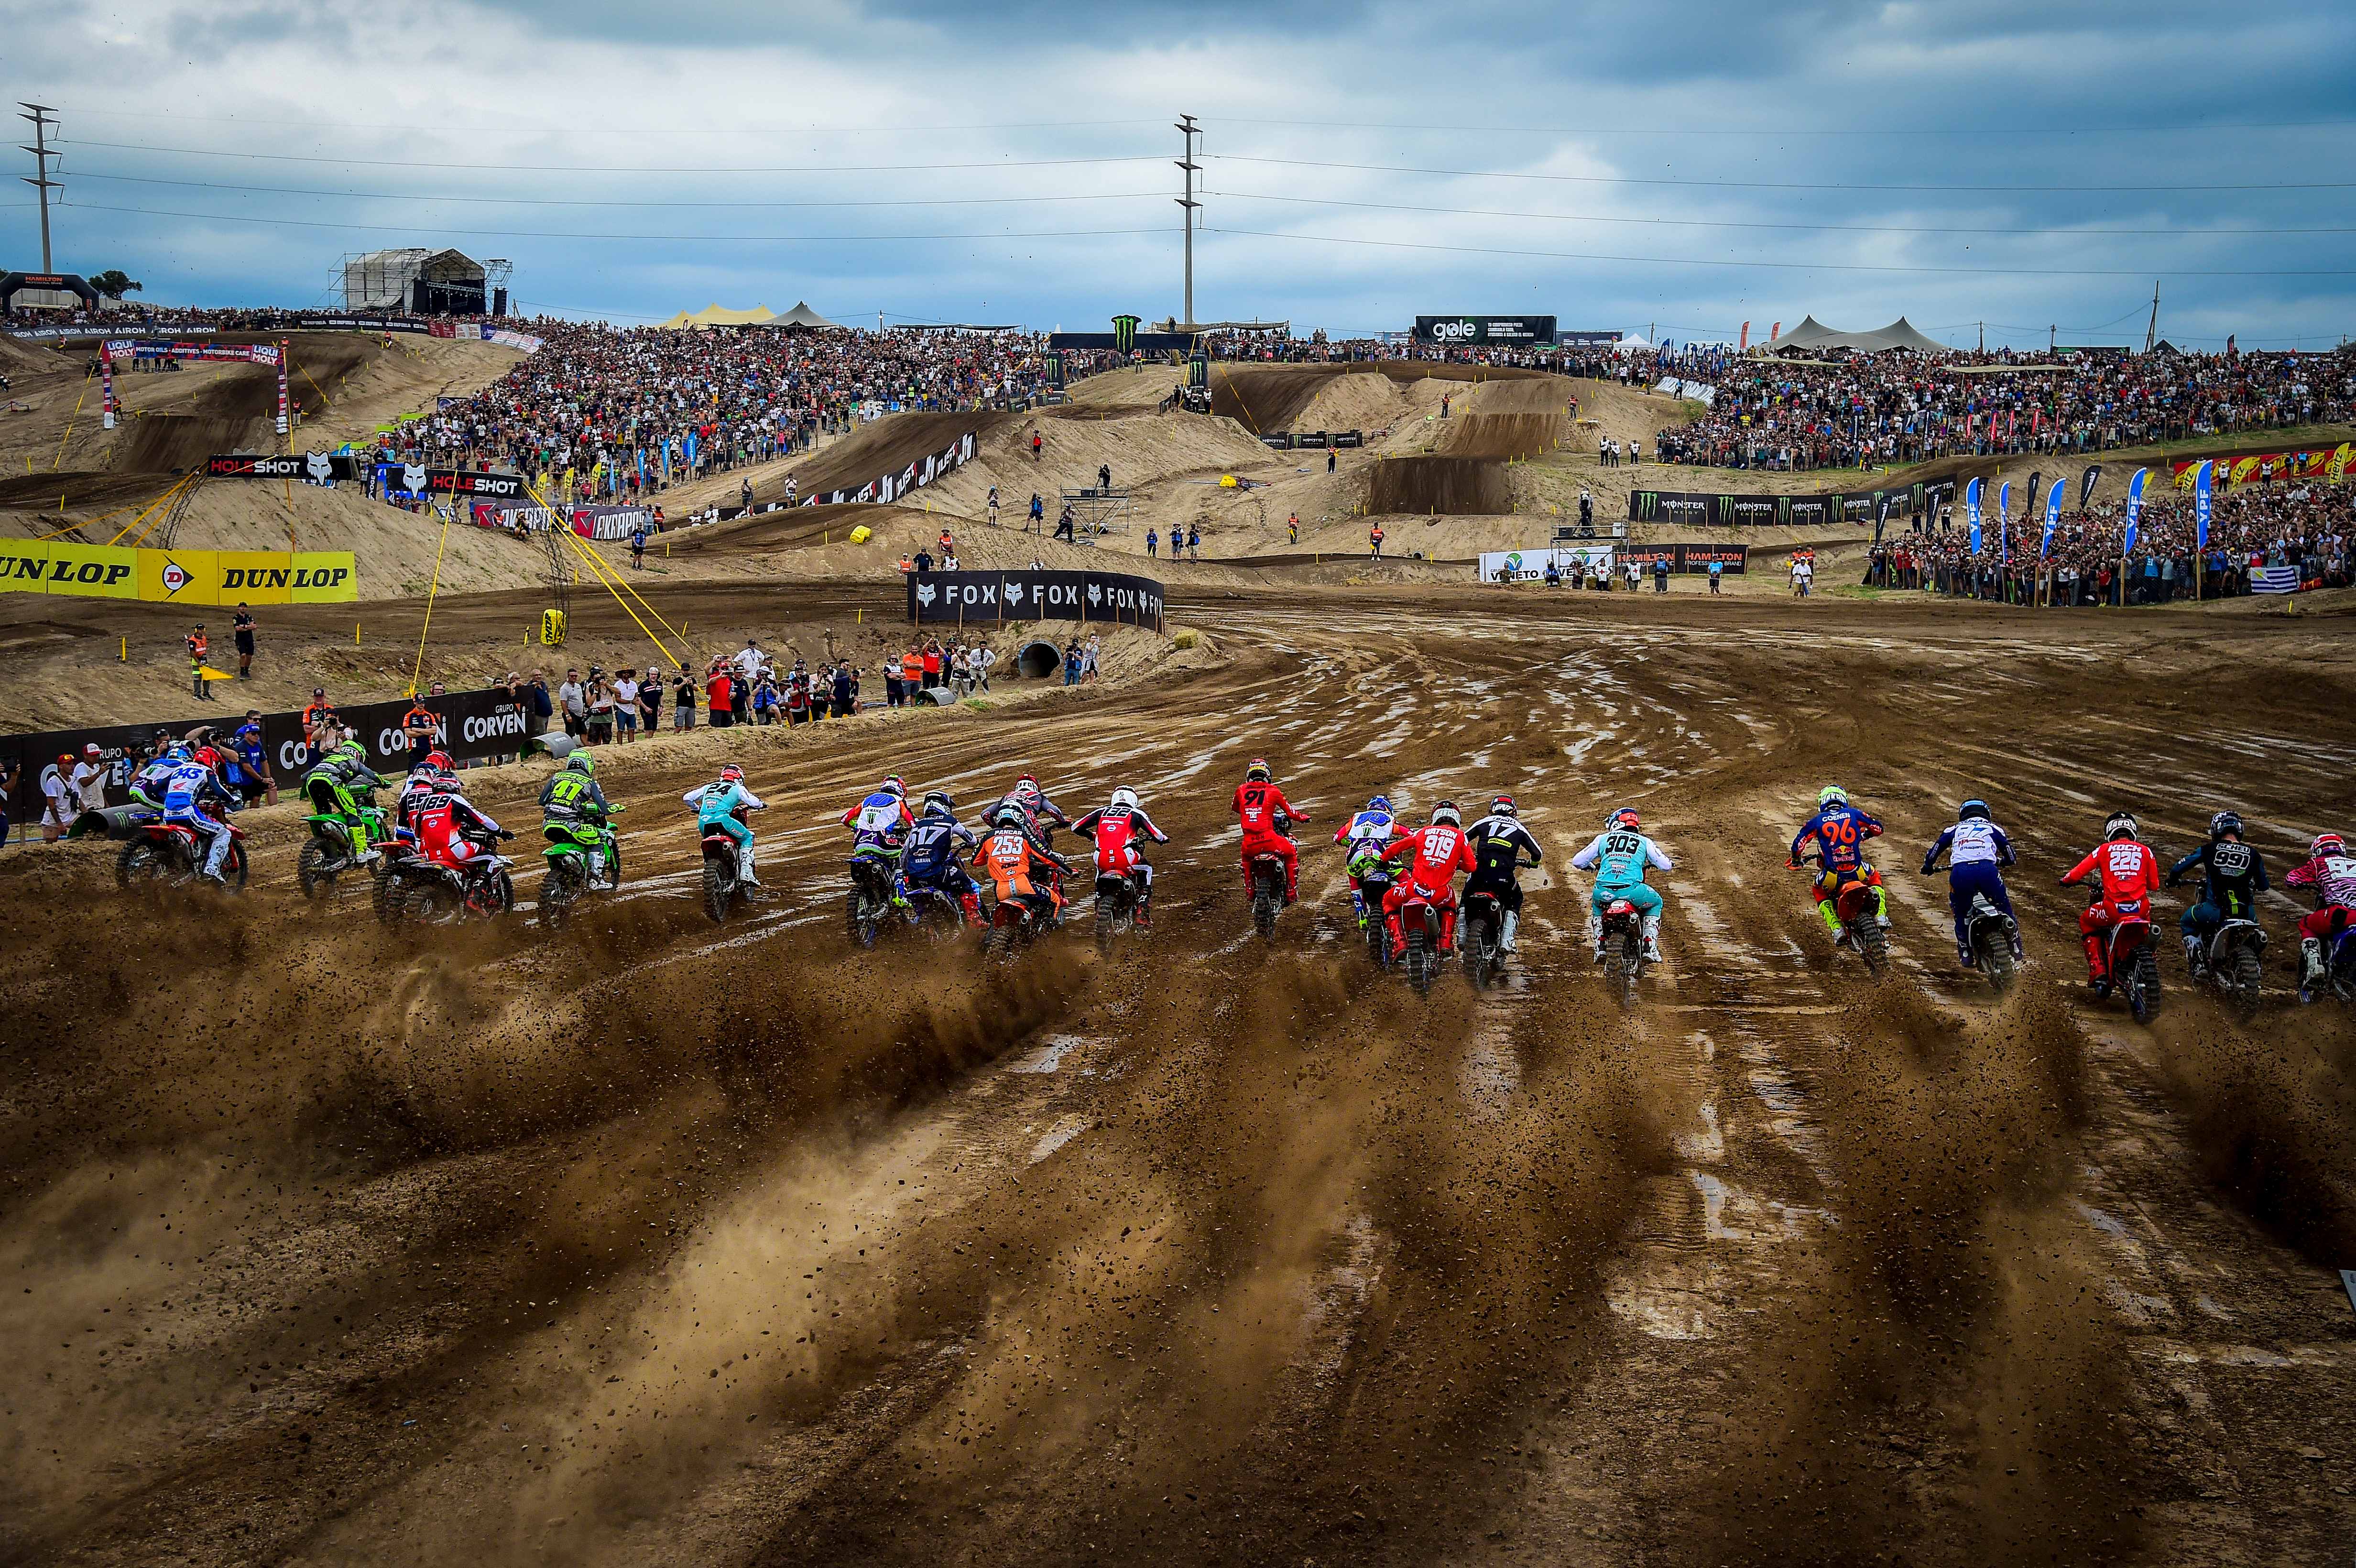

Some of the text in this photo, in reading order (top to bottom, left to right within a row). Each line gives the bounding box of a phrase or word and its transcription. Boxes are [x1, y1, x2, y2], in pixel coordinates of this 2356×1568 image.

[1433, 318, 1476, 341] gole
[107, 340, 132, 350] LIQUI
[109, 348, 135, 359] MOLY
[253, 345, 279, 357] LIQUI
[252, 354, 278, 365] MOLY
[210, 460, 300, 474] HOLESHOT
[2331, 452, 2343, 481] Hertz
[433, 475, 517, 495] HOLESHOT
[2182, 471, 2194, 495] ertz
[1735, 501, 1772, 512] MONSTER
[1792, 502, 1822, 512] MONSTER
[2128, 495, 2139, 529] YPF
[2199, 489, 2209, 523] YPF
[1969, 502, 1978, 533] YPF
[2045, 505, 2058, 537] YPF
[0, 556, 131, 585] UNLOP
[222, 568, 348, 589] DUNLOP
[946, 585, 997, 605] FOX
[1033, 585, 1078, 605] FOX
[1107, 588, 1136, 610] FOX
[1149, 594, 1163, 617] FOX
[495, 703, 514, 714] GRUPO
[99, 747, 122, 761] RUPO
[172, 767, 203, 780] 243
[552, 780, 584, 801] 41
[706, 783, 732, 796] 24
[1244, 790, 1266, 806] 91
[421, 795, 451, 811] 189
[1102, 807, 1131, 817] 132
[1822, 813, 1851, 822] COENEN
[1425, 828, 1458, 839] WATSON
[1488, 821, 1517, 838] 17
[1822, 818, 1856, 844] 96
[992, 836, 1024, 856] 253
[1423, 835, 1455, 860] 919
[1605, 836, 1640, 855] 303
[2216, 843, 2250, 854] SCHEU
[2109, 851, 2143, 871] 226
[2214, 850, 2250, 870] 991
[2089, 907, 2108, 919] FXR
